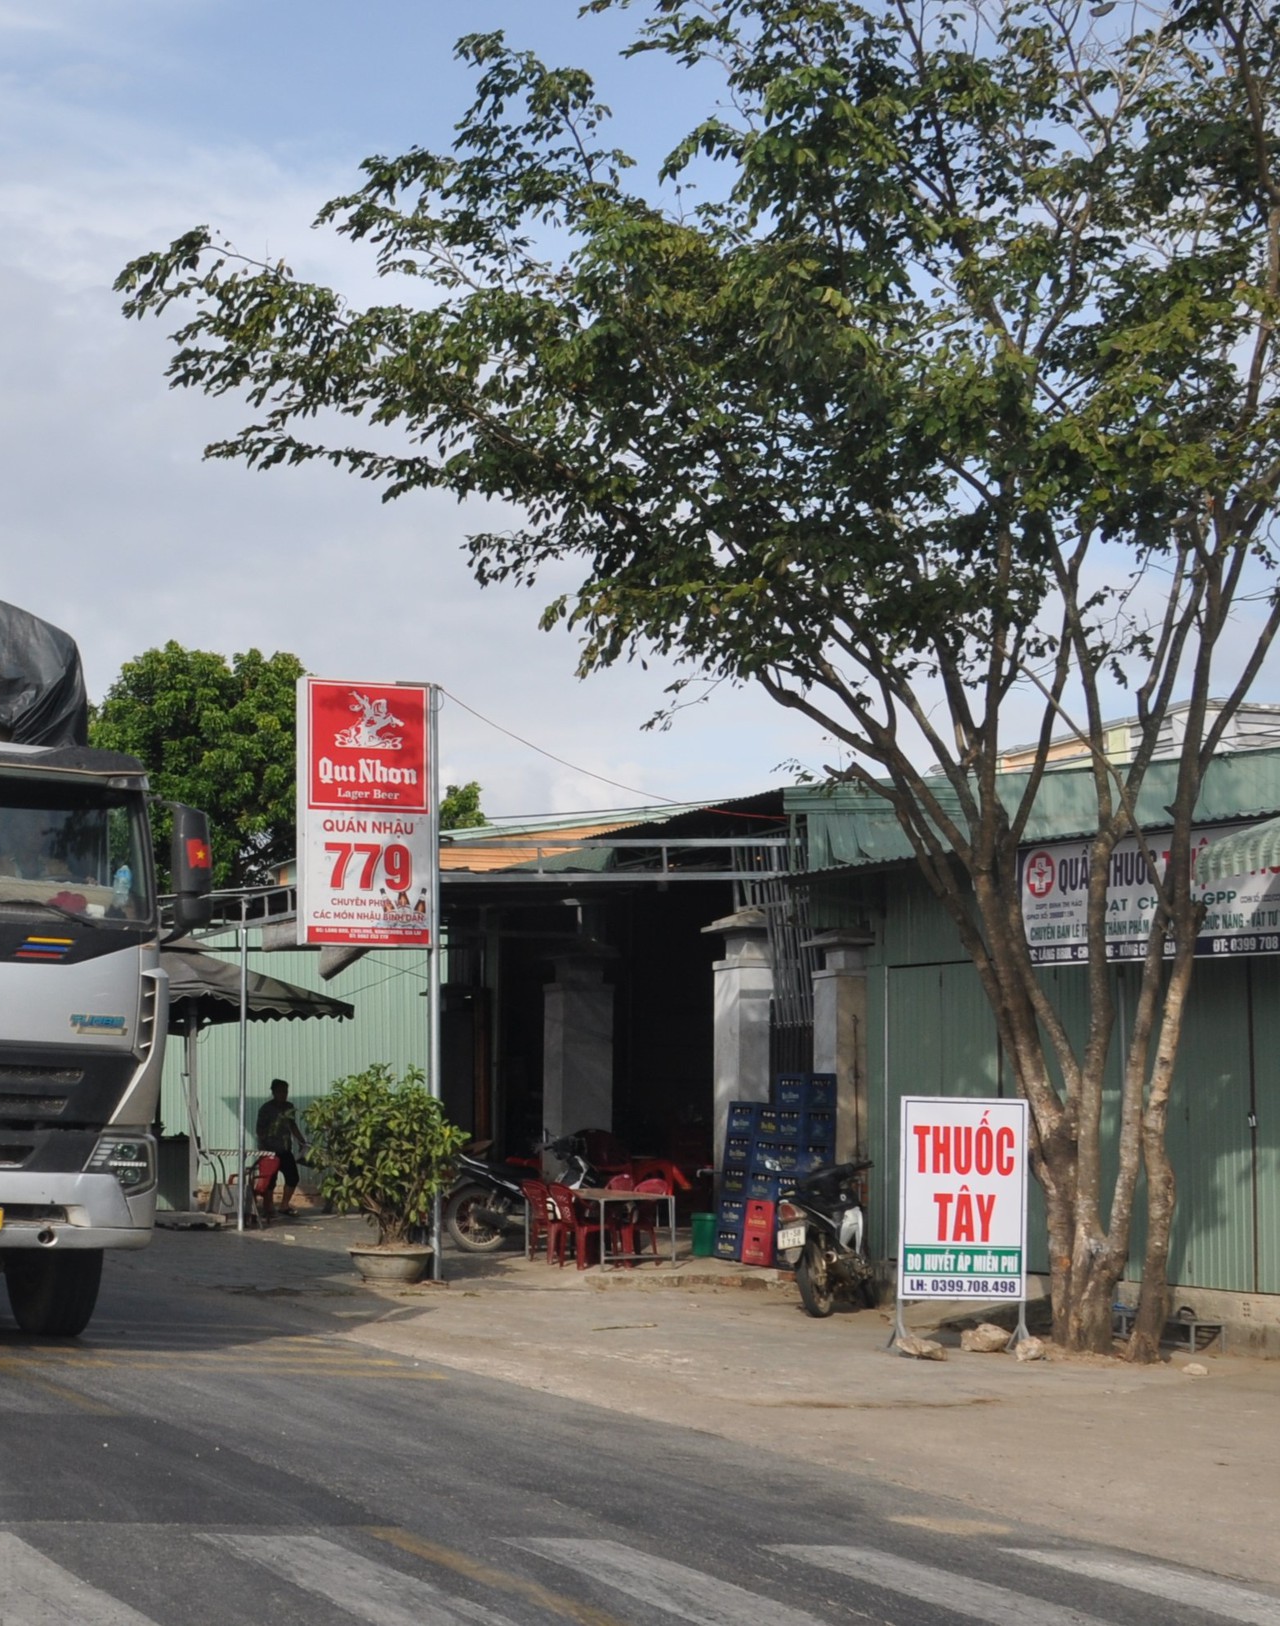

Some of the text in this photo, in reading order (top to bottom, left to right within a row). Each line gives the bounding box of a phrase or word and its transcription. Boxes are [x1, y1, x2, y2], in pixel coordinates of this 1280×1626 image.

[337, 787, 400, 801] Lager Beer
[323, 815, 414, 839] QUÁN NHẬU
[324, 841, 413, 893] 779
[1058, 844, 1090, 896] QUẦ
[331, 896, 366, 907] CHUYÊN
[1202, 890, 1237, 906] GPP
[313, 909, 331, 919] CÁC
[333, 910, 354, 920] MÓN
[357, 911, 381, 922] NHẬU
[1212, 938, 1229, 953] ĐT:
[1230, 936, 1257, 953] 0399
[1258, 935, 1279, 951] 708
[913, 1110, 1015, 1176] THUỐC
[933, 1184, 996, 1242] TÂY
[924, 1249, 956, 1272] HUYẾT
[957, 1251, 972, 1272] ÁP
[973, 1250, 999, 1272] MIỄN
[1000, 1252, 1019, 1273] PHÍ
[910, 1279, 1016, 1293] LH: 0399.708.498
